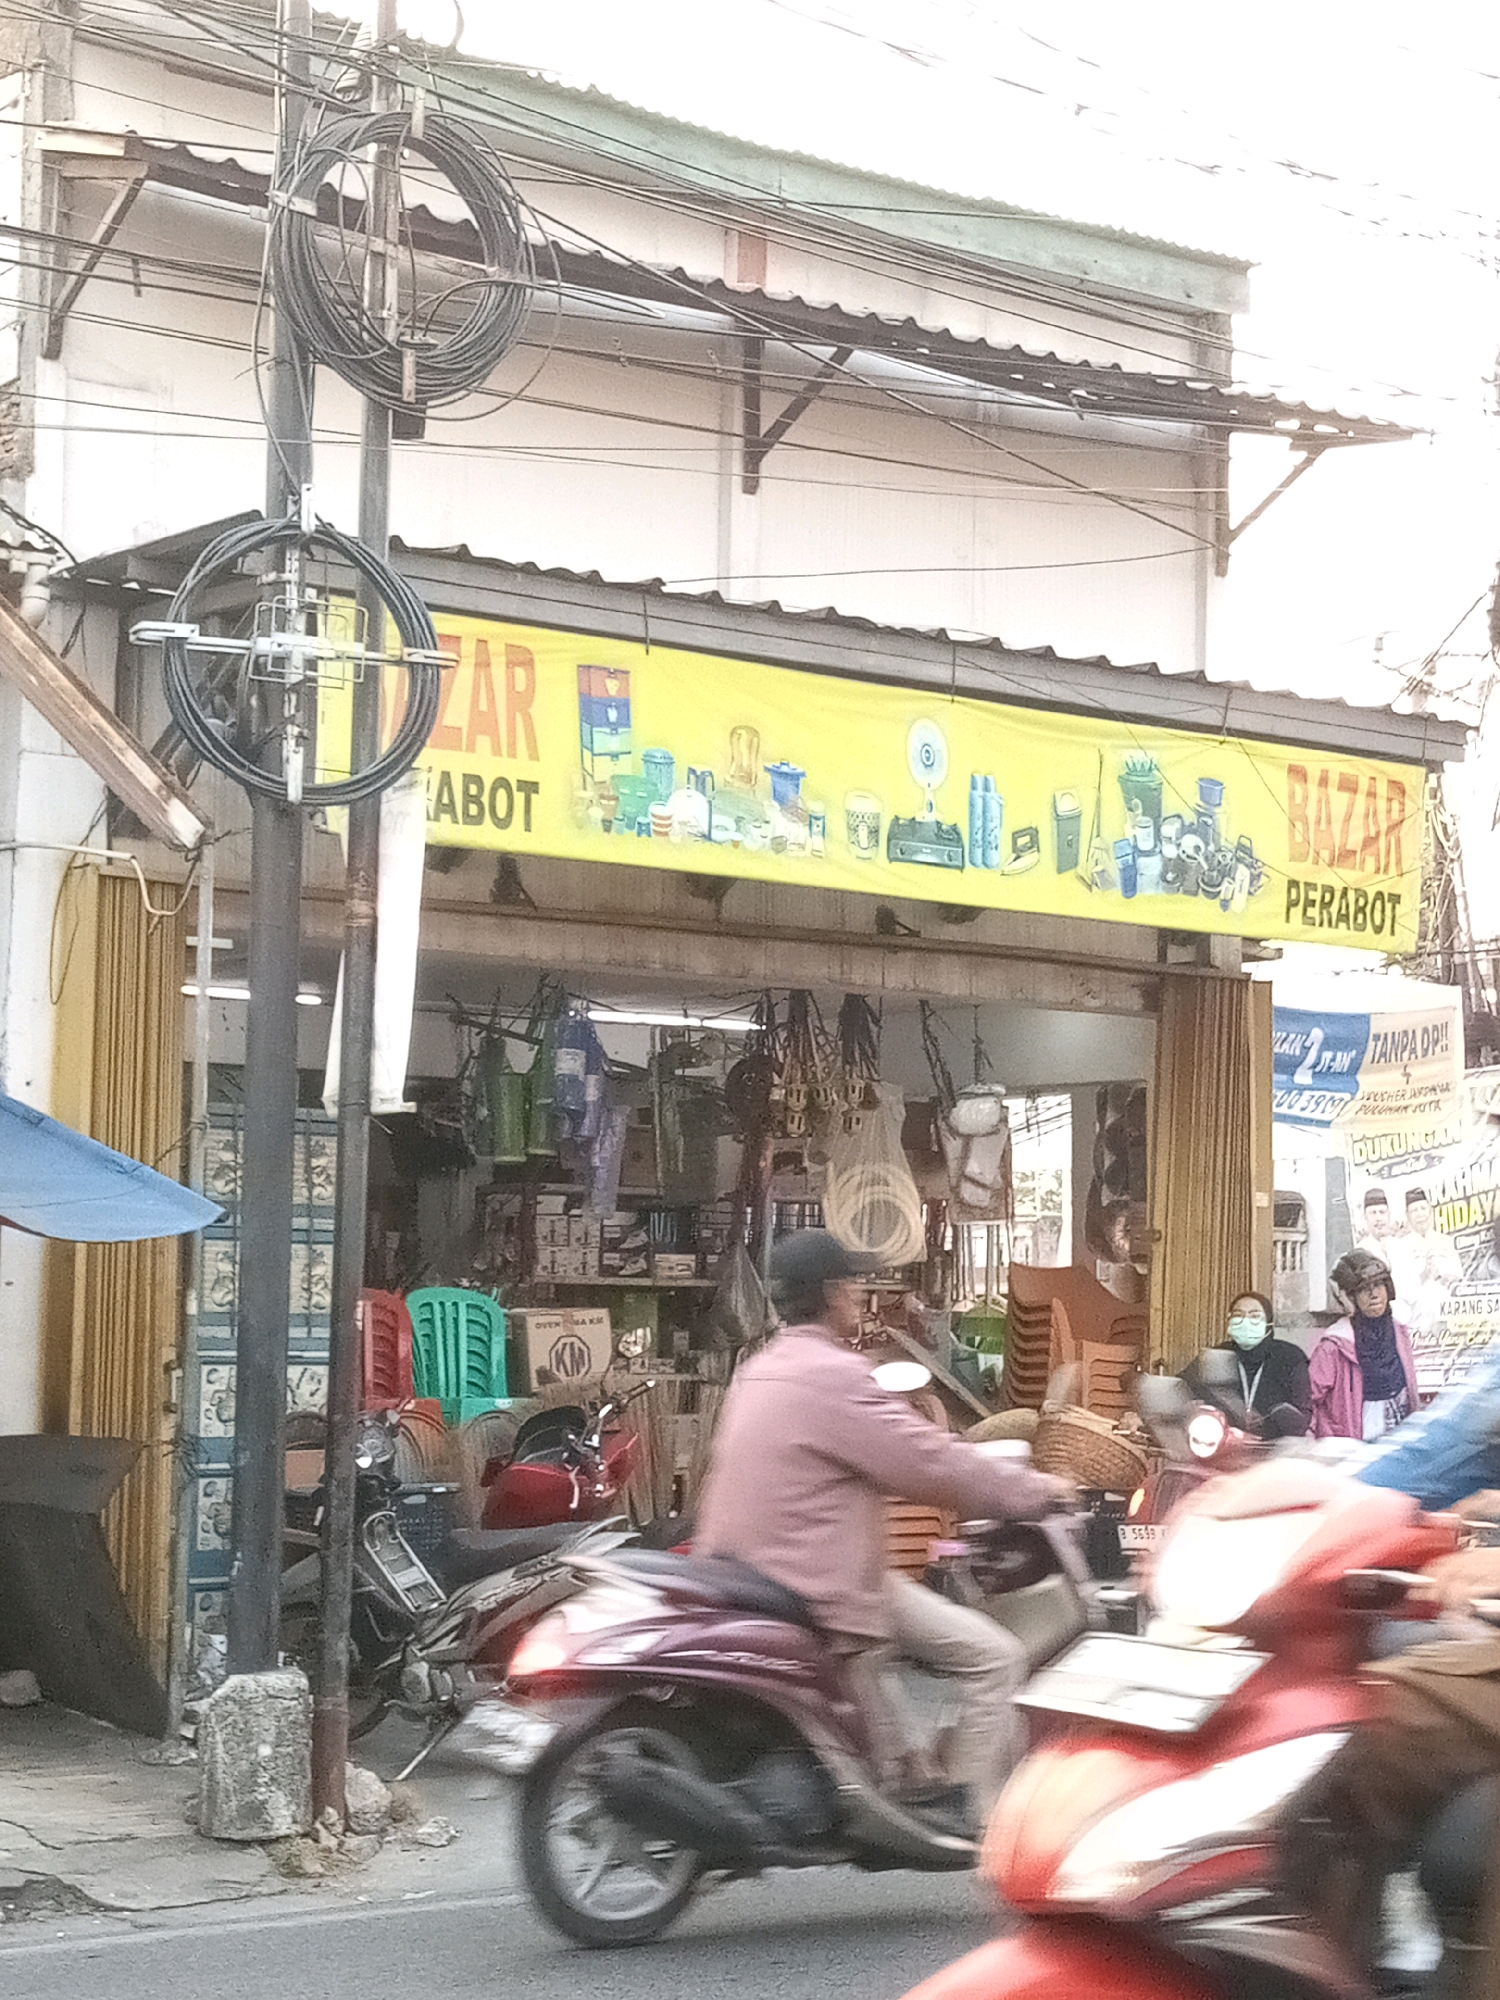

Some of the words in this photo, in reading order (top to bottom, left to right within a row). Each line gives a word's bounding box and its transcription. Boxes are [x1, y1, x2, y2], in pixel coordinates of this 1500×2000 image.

[378, 634, 540, 762] ZAR
[1286, 763, 1406, 876] BAZAR
[1285, 879, 1401, 936] PERABOT
[1294, 1027, 1324, 1084] 2
[1370, 1029, 1418, 1064] TANPA
[1421, 1021, 1449, 1058] DP!!
[1352, 1124, 1461, 1166] DUKUNGAN
[1440, 1300, 1483, 1316] KARANG
[554, 1341, 586, 1377] KM
